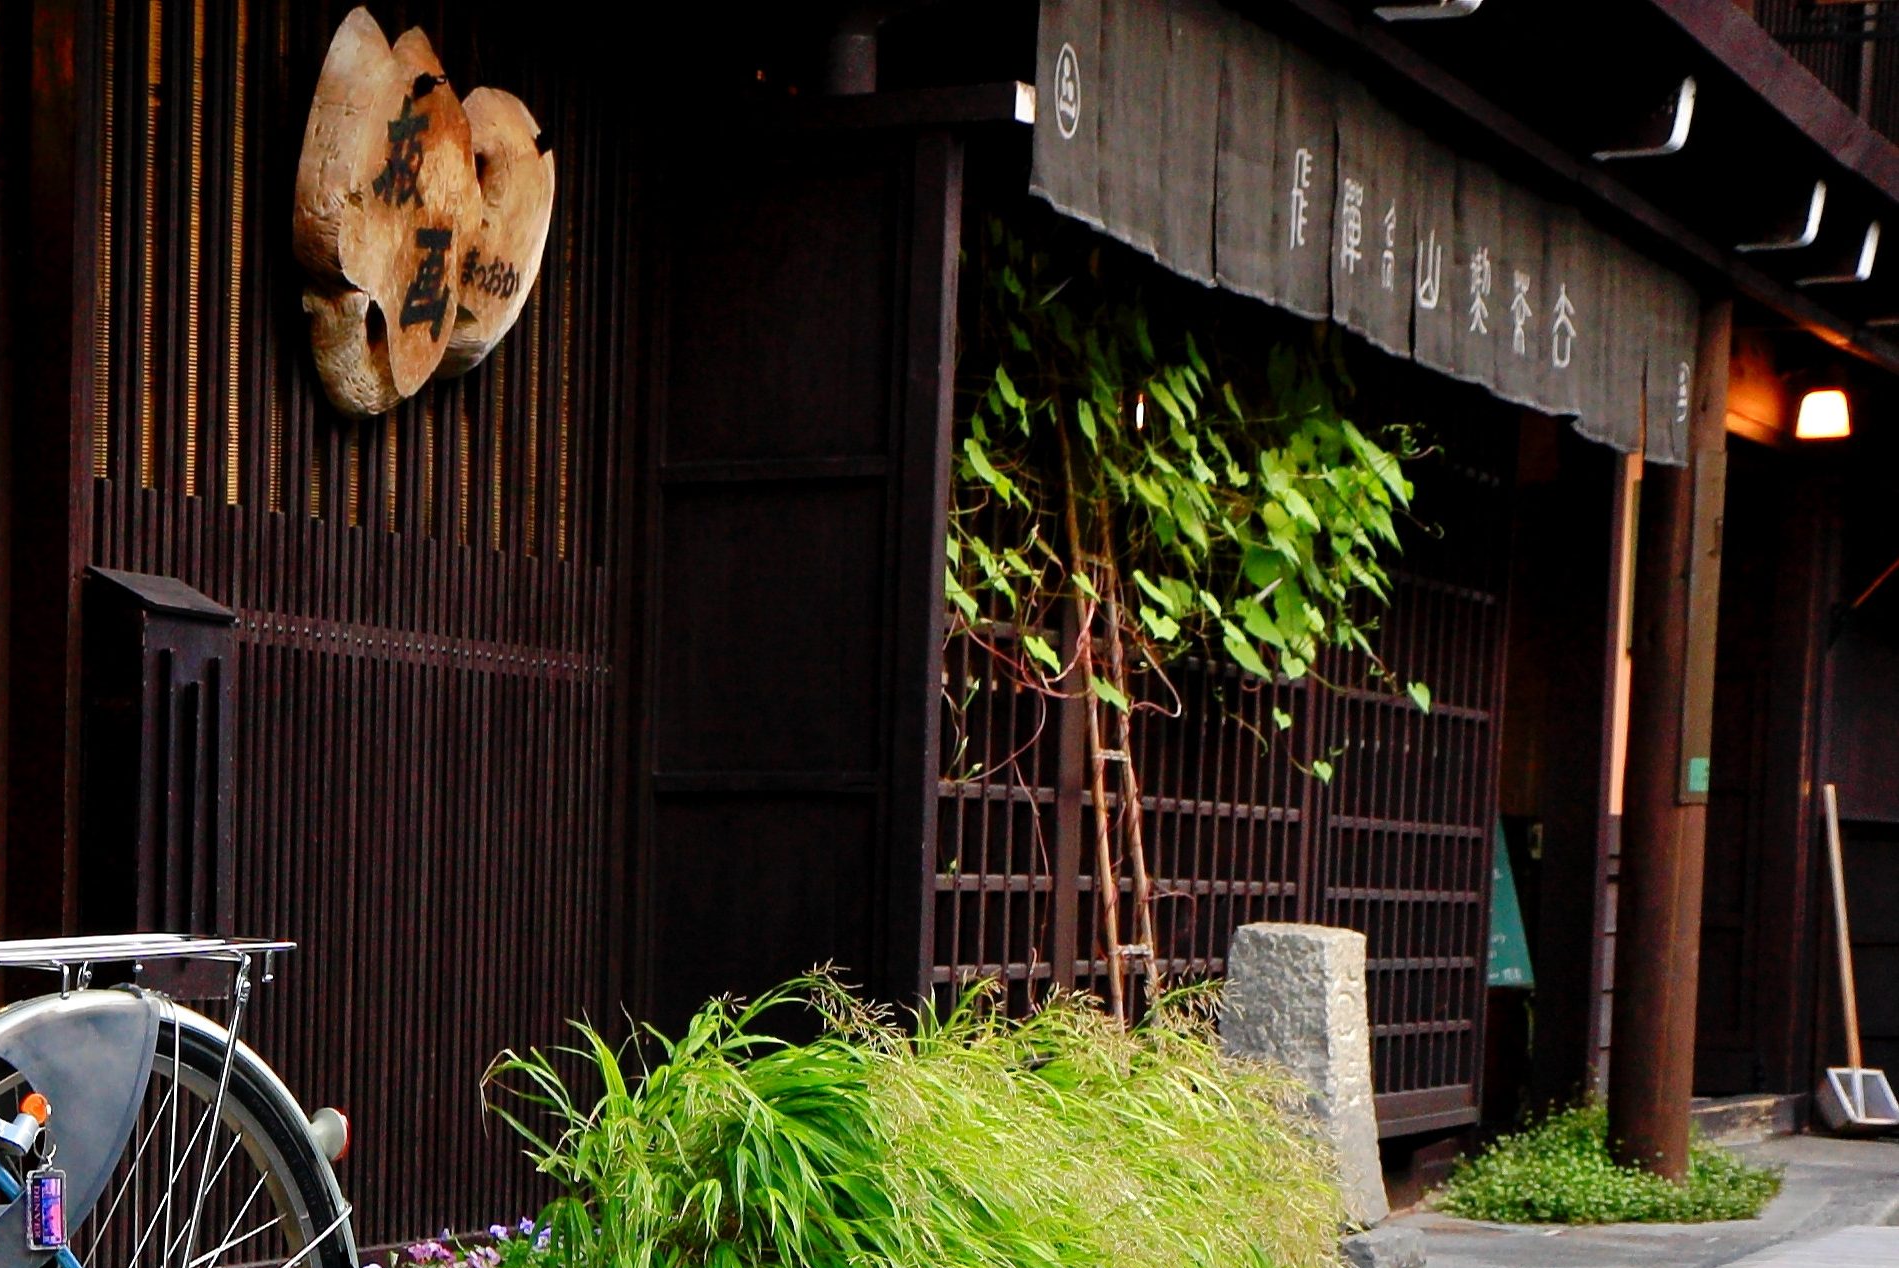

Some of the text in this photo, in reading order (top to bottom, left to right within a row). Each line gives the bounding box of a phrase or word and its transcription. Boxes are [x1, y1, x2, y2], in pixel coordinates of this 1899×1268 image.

[461, 247, 520, 299] まつおか
[34, 1185, 42, 1238] DENVER
